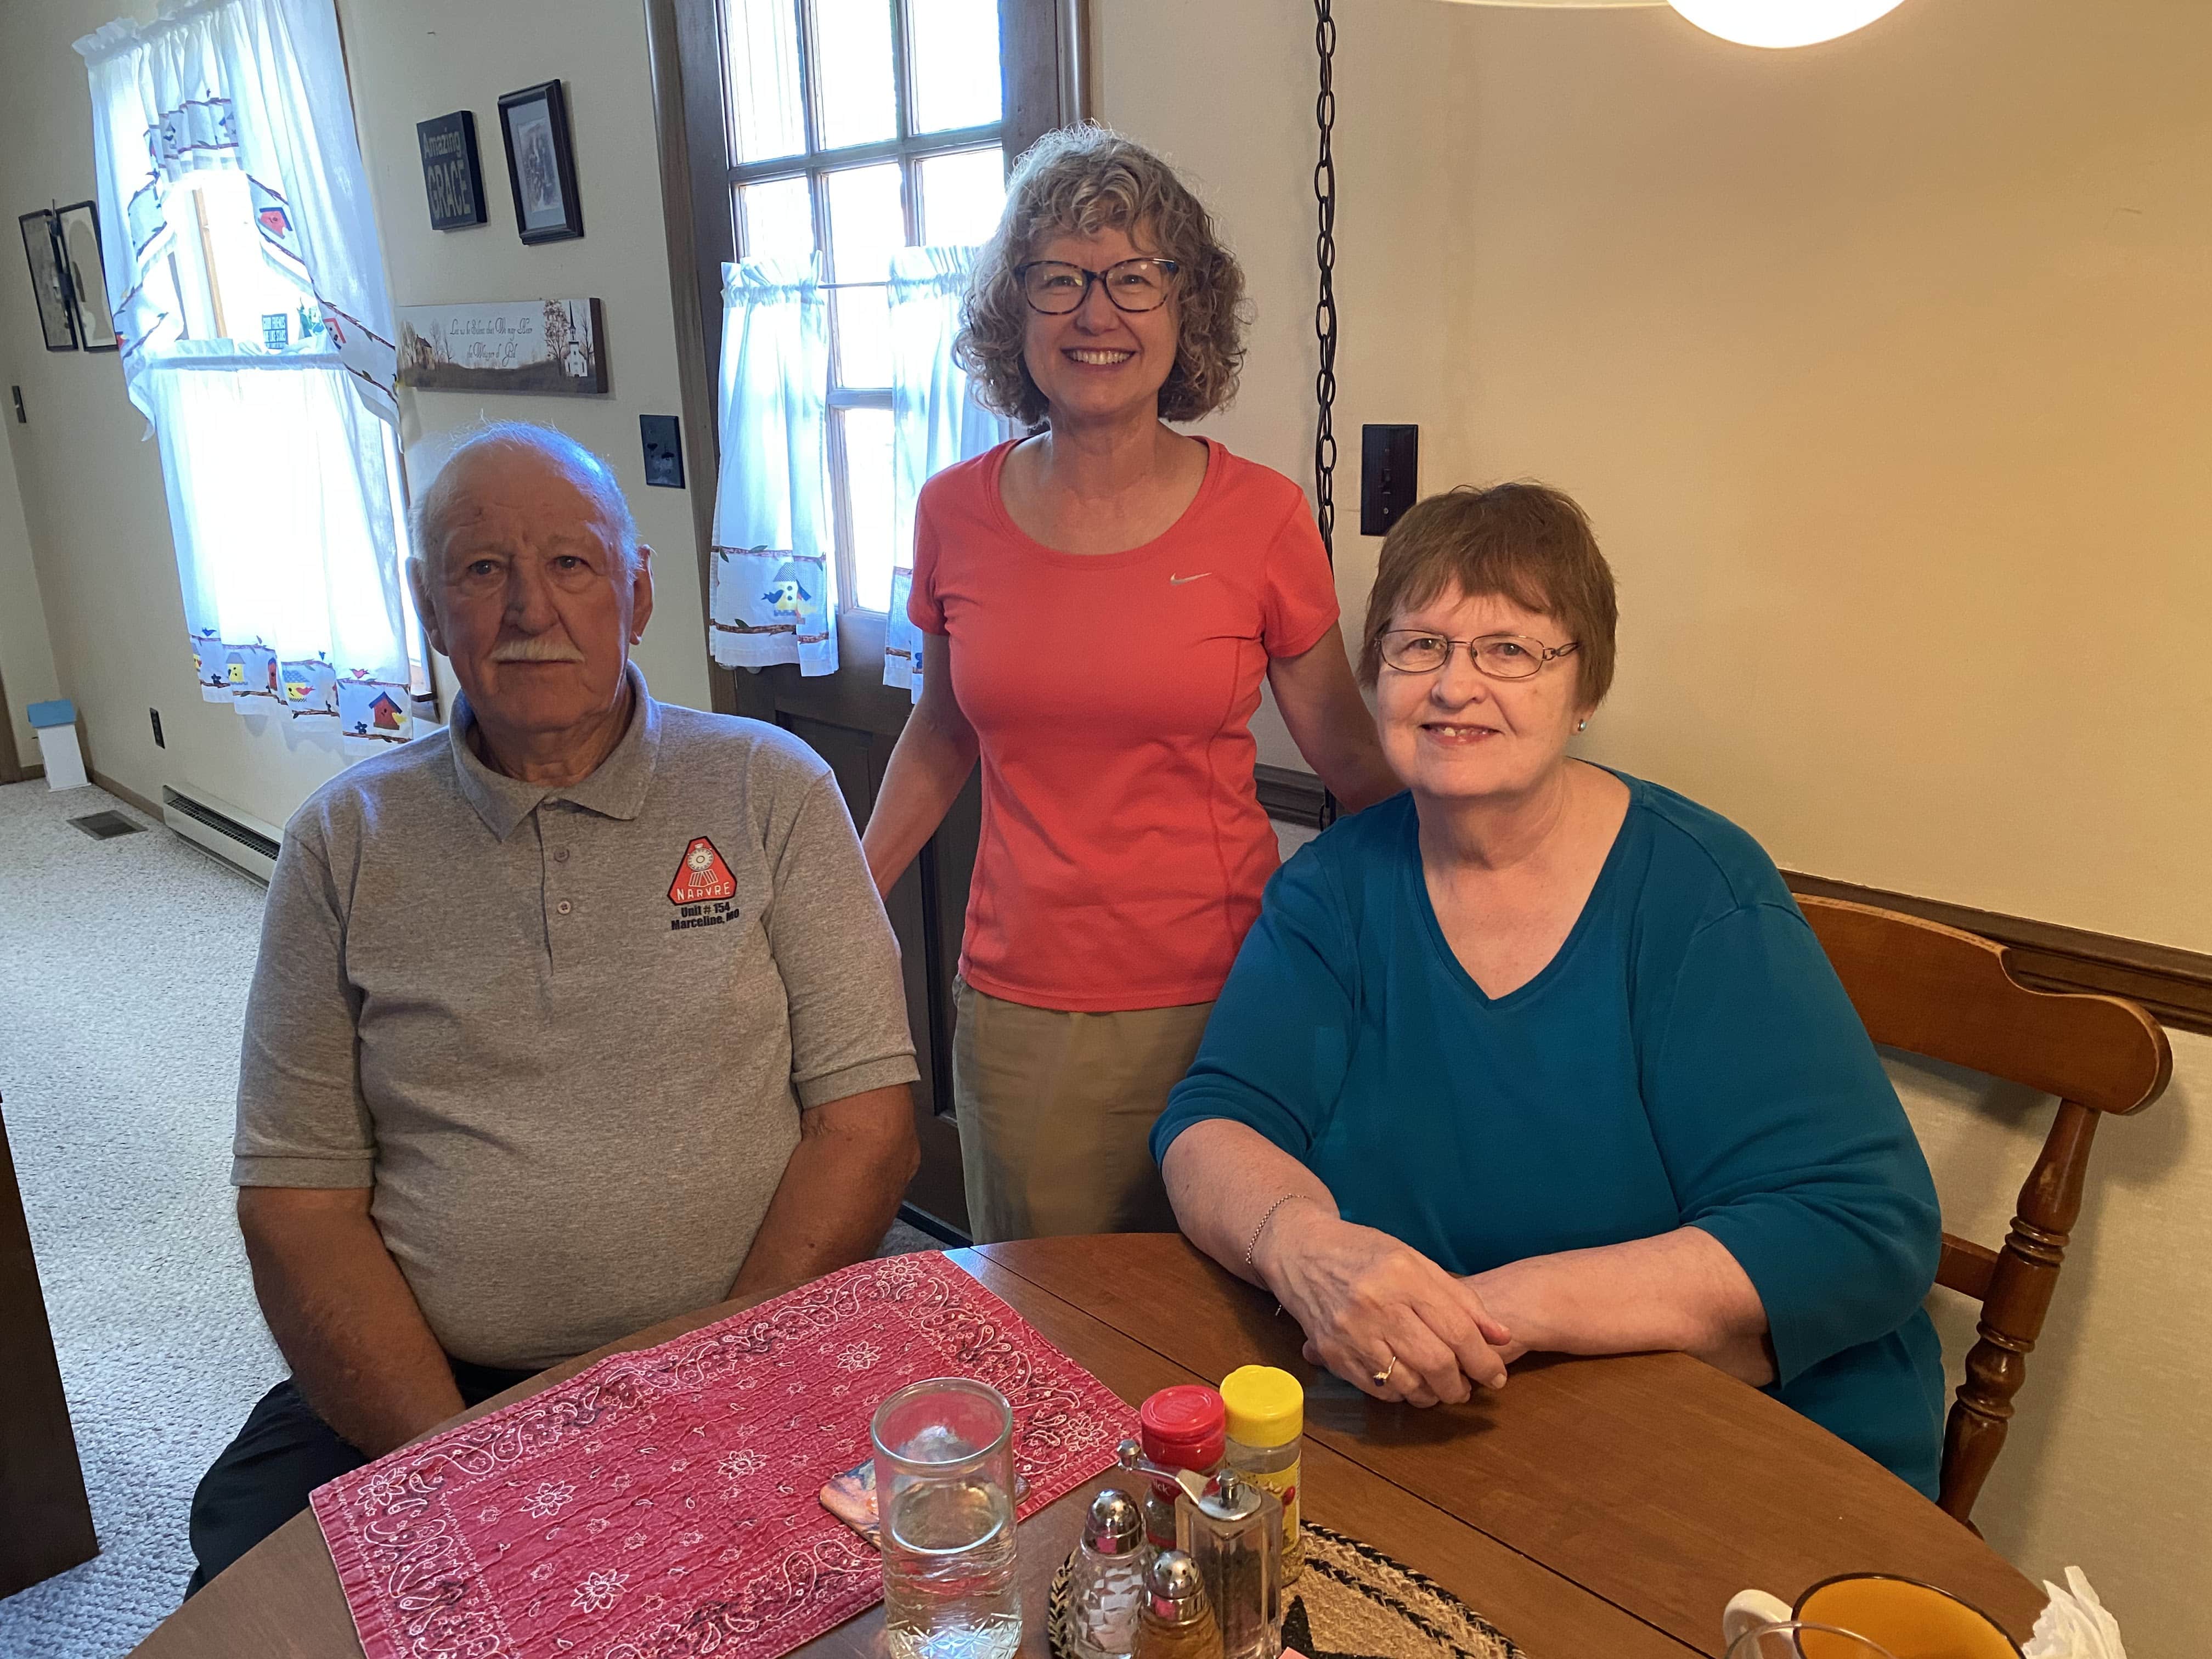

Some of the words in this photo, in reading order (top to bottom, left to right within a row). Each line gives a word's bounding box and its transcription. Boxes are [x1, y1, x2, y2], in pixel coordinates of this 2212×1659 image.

[424, 127, 461, 159] Amazing
[428, 160, 471, 219] GRACE
[676, 882, 731, 900] NARVRE
[671, 916, 725, 930] Marceline,
[726, 909, 740, 922] MO
[681, 905, 702, 918] Unit
[703, 905, 712, 914] #
[713, 902, 730, 913] 154
